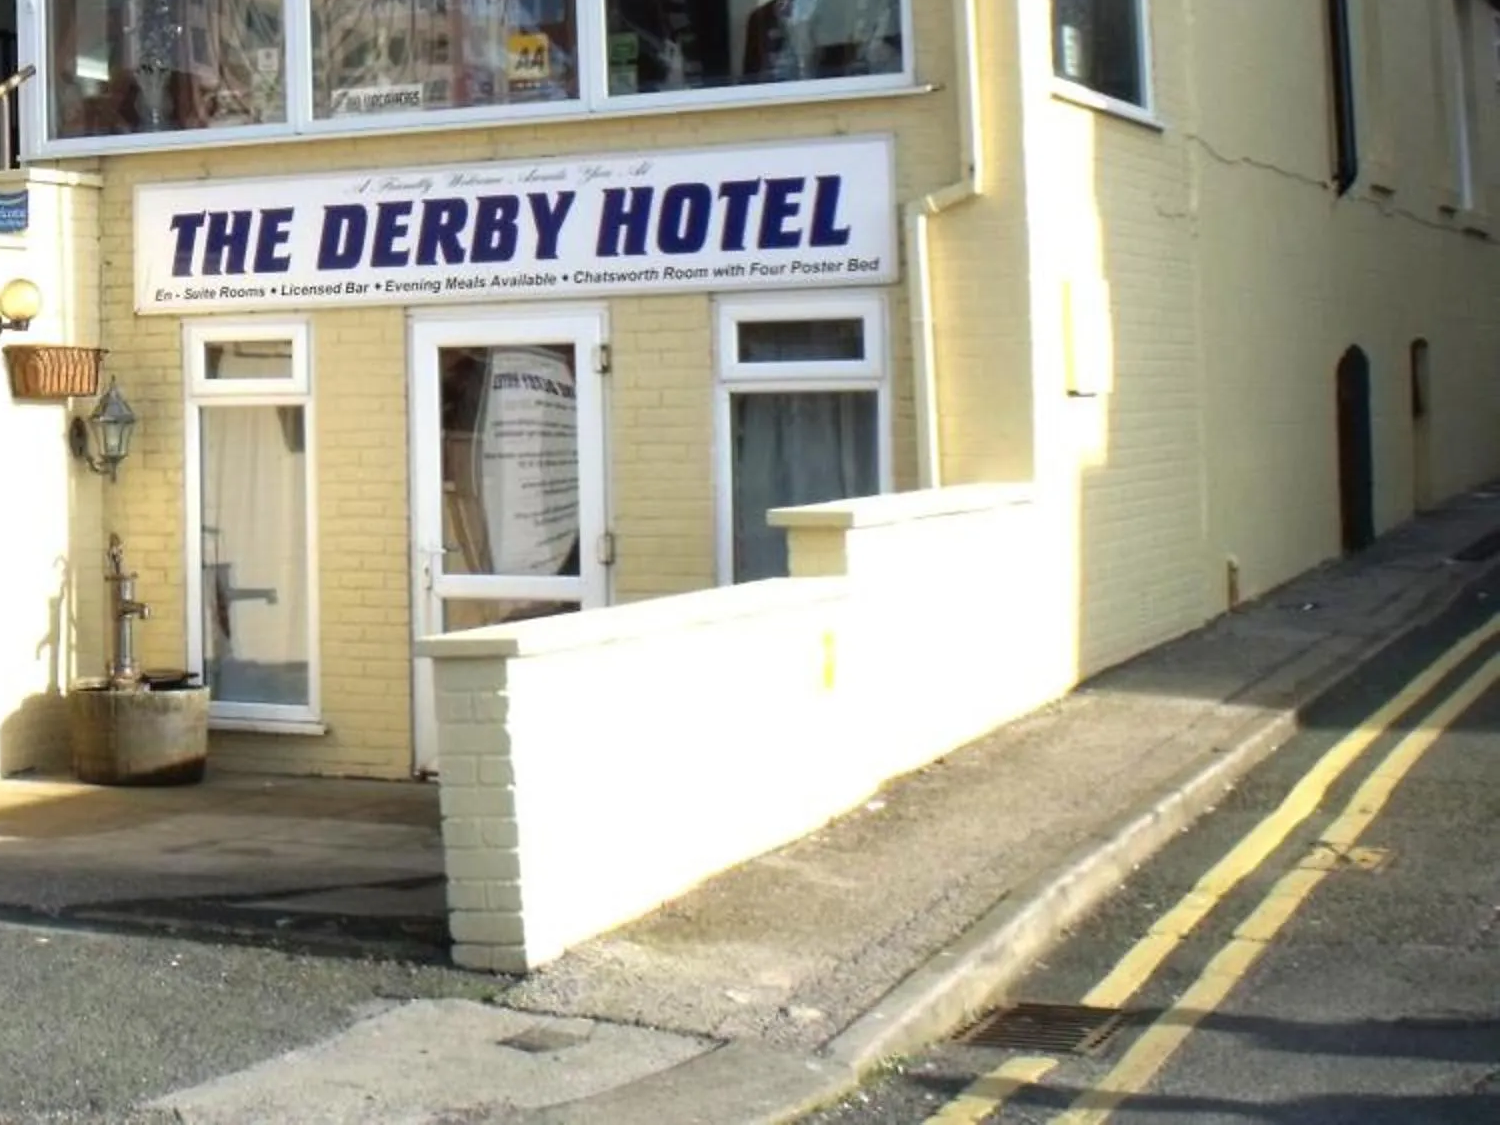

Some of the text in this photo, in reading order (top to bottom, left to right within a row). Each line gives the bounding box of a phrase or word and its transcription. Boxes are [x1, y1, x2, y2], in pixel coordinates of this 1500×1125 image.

[169, 175, 852, 277] THE DERBY HOTEL
[220, 283, 266, 299] Rooms
[281, 282, 342, 297] Licensed
[345, 281, 370, 295] Bar
[385, 278, 442, 295] Evening
[445, 275, 486, 291] Meals
[491, 273, 556, 289] Available
[573, 268, 659, 286] Chatsworth
[663, 265, 709, 280] Room
[712, 263, 746, 277] with
[750, 261, 786, 275] Four
[790, 258, 844, 274] Poster
[847, 257, 881, 272] Bed
